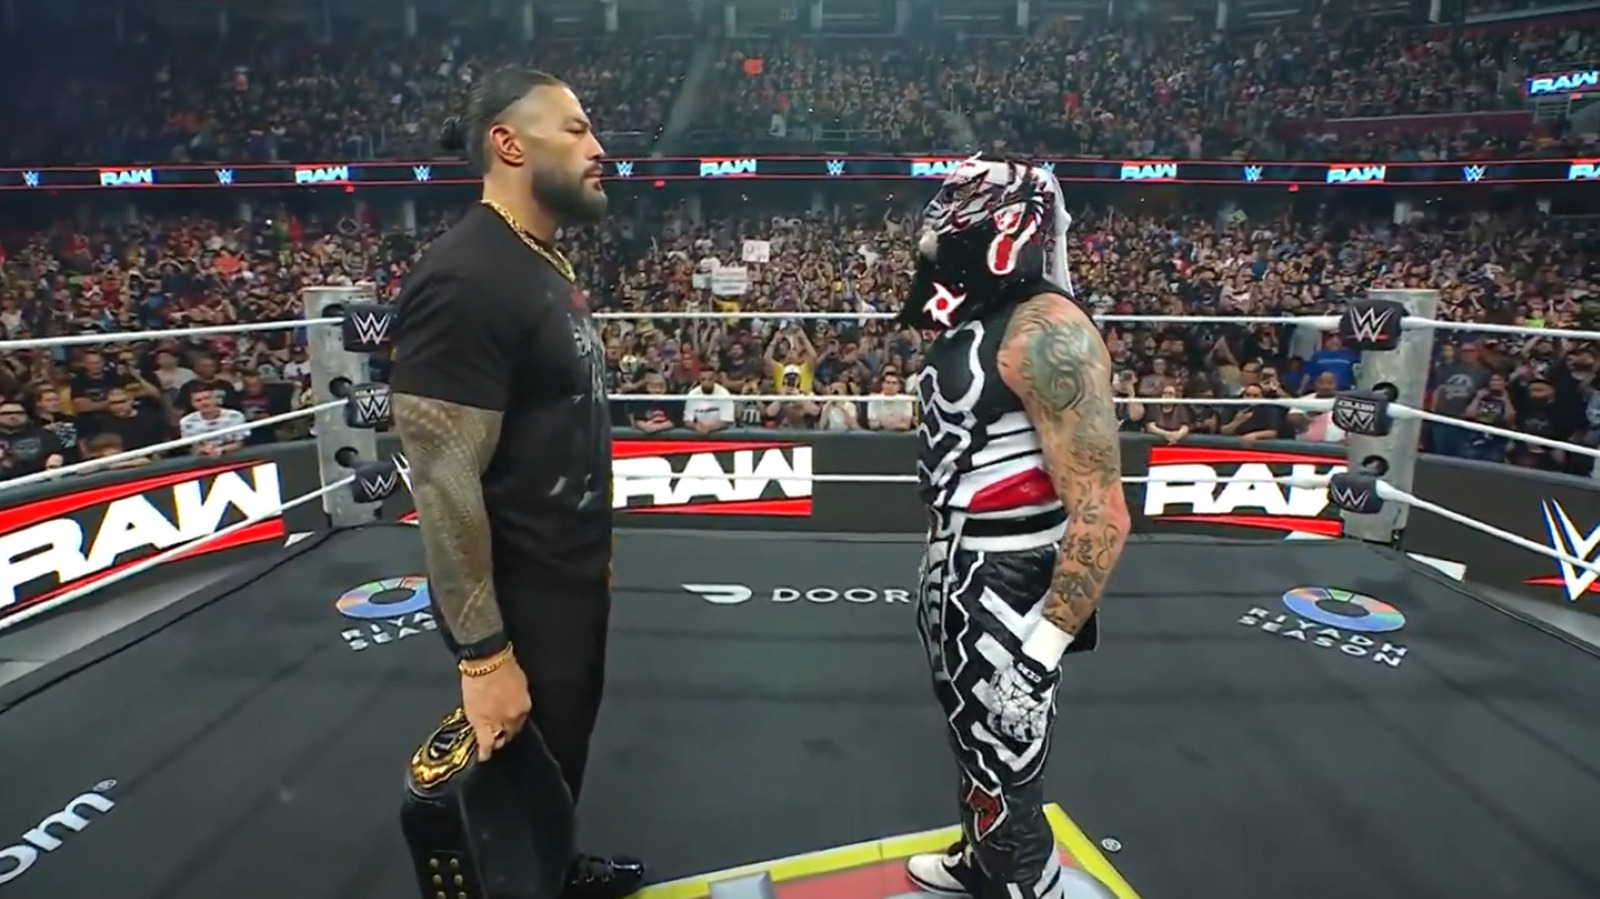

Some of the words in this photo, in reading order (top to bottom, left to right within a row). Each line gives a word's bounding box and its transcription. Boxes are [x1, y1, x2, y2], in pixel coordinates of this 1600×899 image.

[1531, 71, 1598, 94] RAW
[295, 166, 348, 184] RAW
[700, 159, 756, 177] RAW
[1121, 163, 1176, 180] RAW
[1327, 166, 1385, 183] RAW
[100, 169, 152, 186] RAW
[612, 447, 813, 509] RAW
[0, 462, 283, 608] RAW
[772, 588, 911, 603] DOOR
[1247, 607, 1408, 657] RIYADH
[1238, 616, 1402, 667] SEASON
